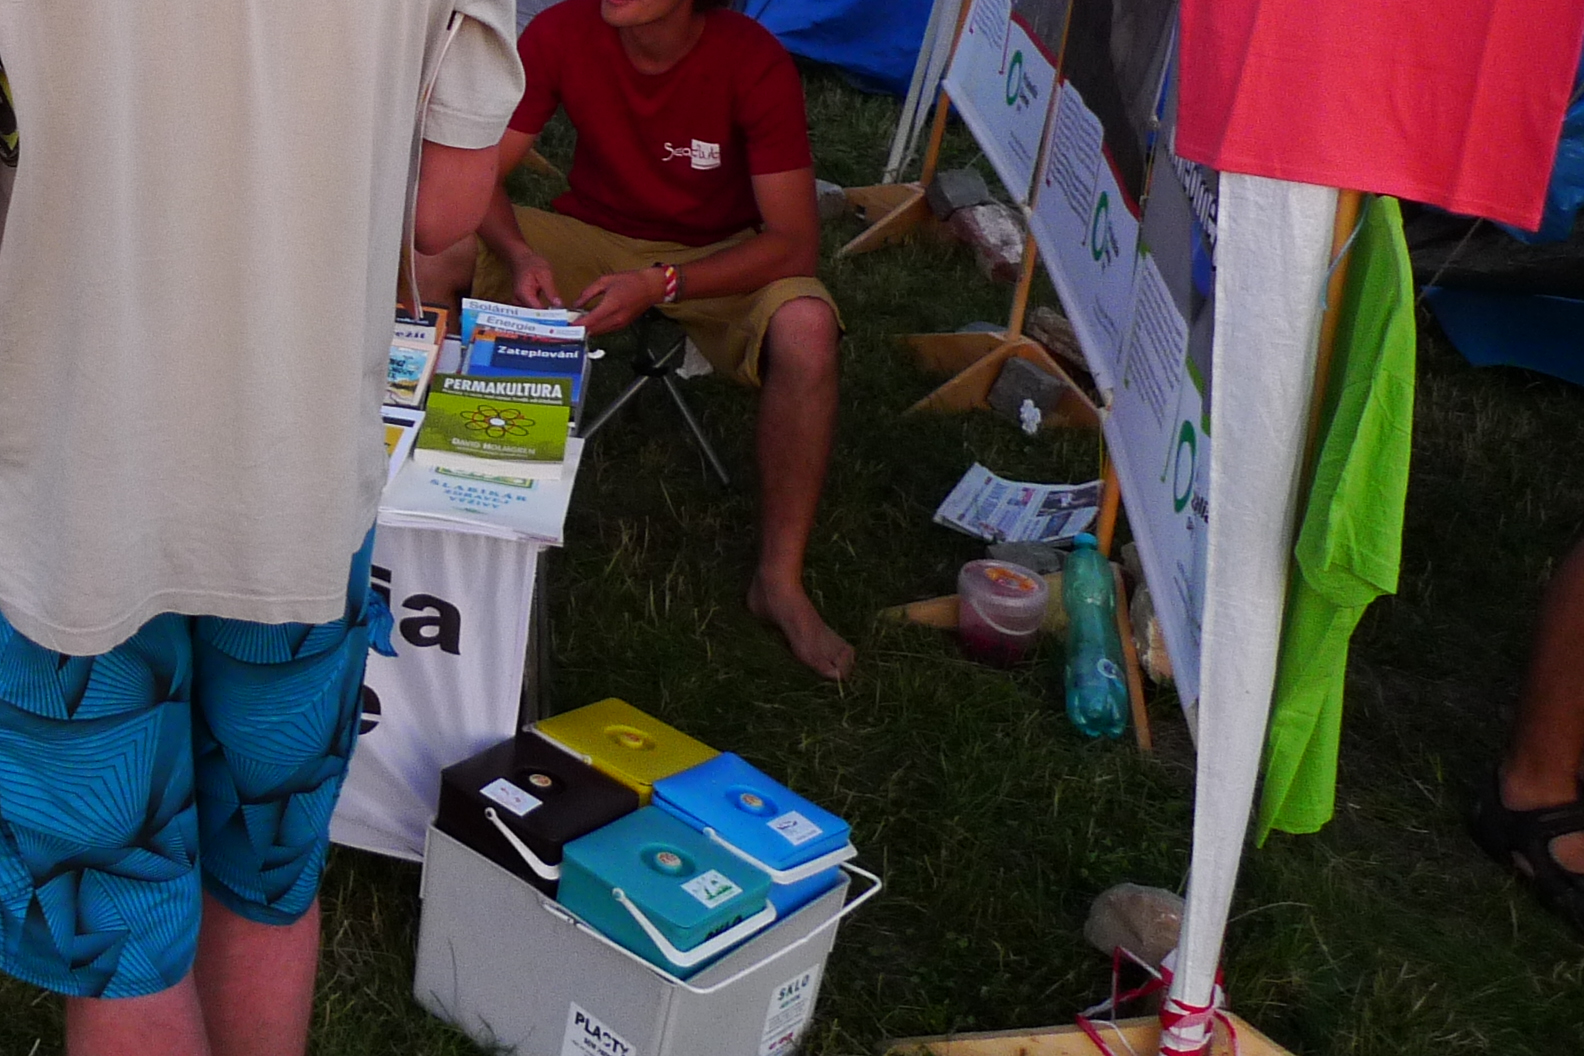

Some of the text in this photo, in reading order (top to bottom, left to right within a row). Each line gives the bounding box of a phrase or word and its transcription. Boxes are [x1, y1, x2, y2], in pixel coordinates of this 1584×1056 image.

[486, 315, 536, 332] Energie
[498, 346, 578, 359] Zateplování
[444, 378, 562, 398] PERMAKULTURA
[451, 438, 480, 448] DAVID
